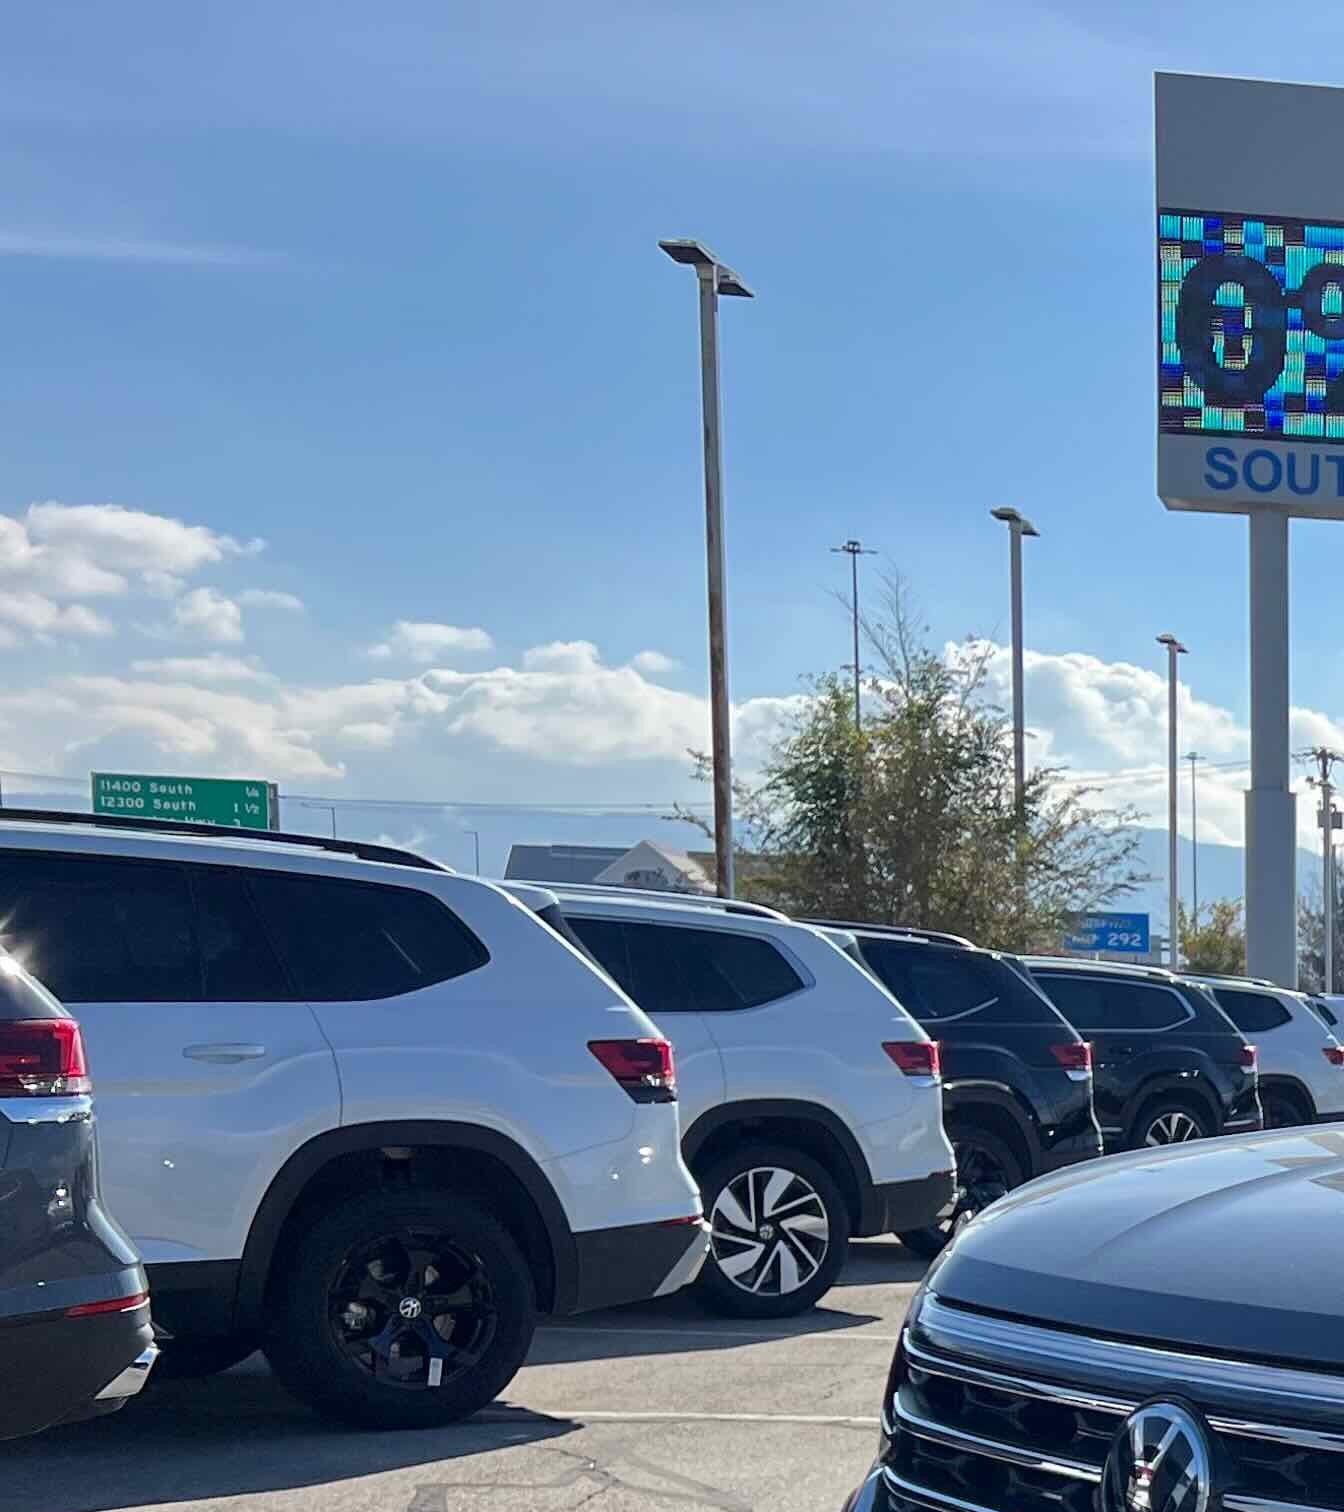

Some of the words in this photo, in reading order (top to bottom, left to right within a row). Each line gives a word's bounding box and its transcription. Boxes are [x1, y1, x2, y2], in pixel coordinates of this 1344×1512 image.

[100, 779, 142, 793] 11400
[150, 782, 193, 795] South
[101, 795, 145, 809] 12300
[153, 798, 197, 812] South
[1107, 932, 1143, 947] 292
